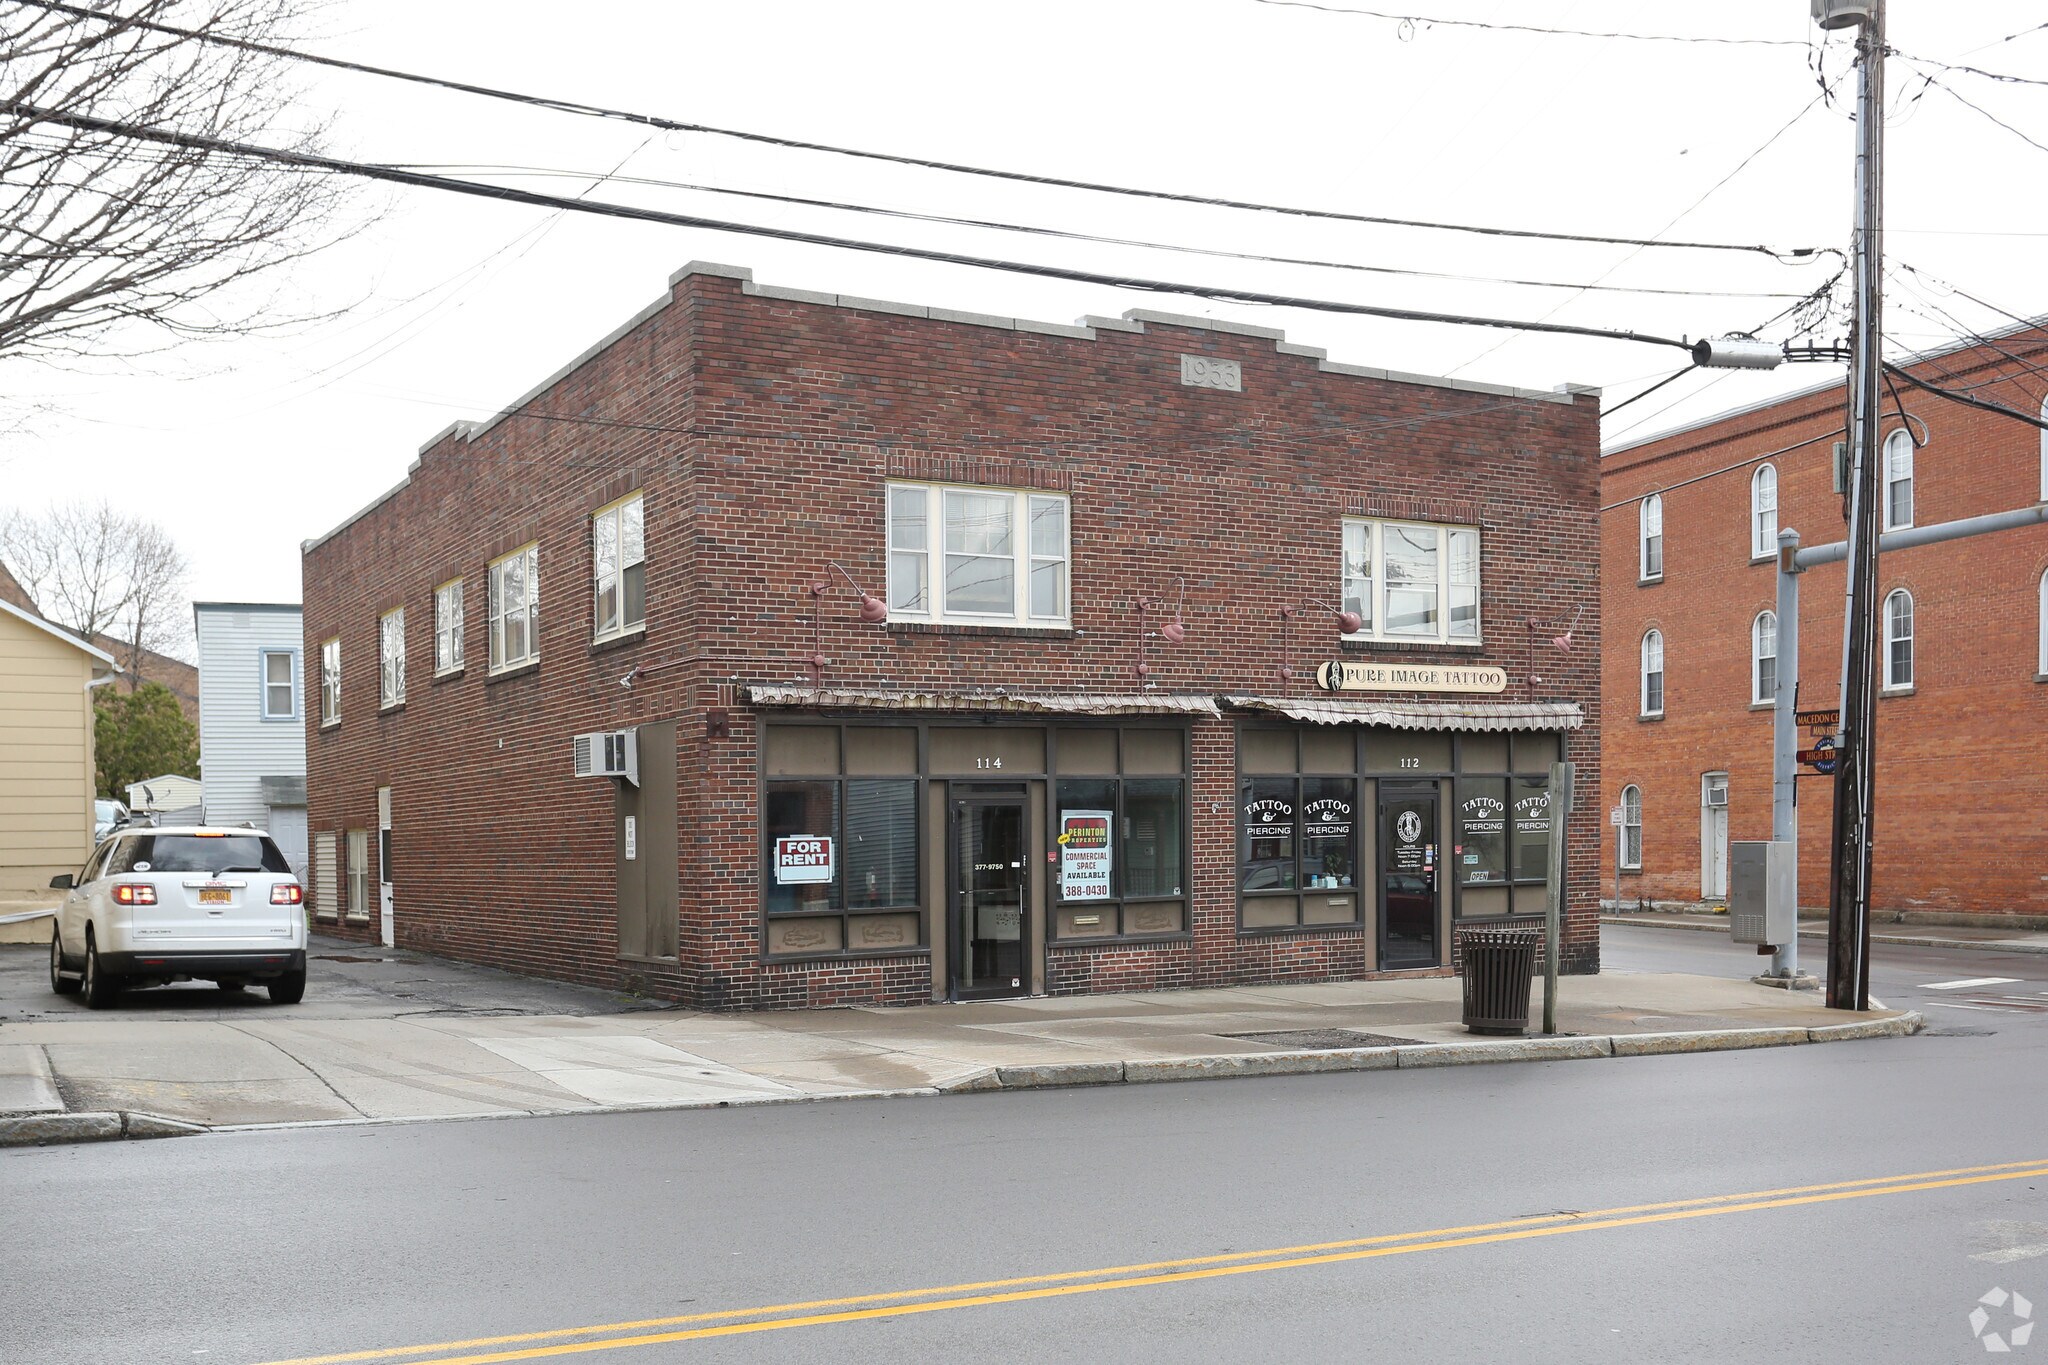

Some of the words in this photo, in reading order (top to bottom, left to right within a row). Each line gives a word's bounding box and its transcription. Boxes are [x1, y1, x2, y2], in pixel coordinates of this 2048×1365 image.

[1346, 669, 1386, 683] PURE
[1391, 670, 1439, 684] IMAGE
[1444, 672, 1501, 686] TATTOO
[1797, 714, 1830, 724] MACEDON
[1830, 713, 1839, 722] CE
[1813, 726, 1826, 736] MAIN
[1826, 726, 1838, 735] STRE
[1806, 751, 1823, 761] HIGH
[1825, 750, 1836, 760] STR
[976, 757, 1002, 769] 114
[1400, 757, 1419, 768] 112
[1244, 799, 1292, 815] TATTOO
[1304, 799, 1350, 815] TATTOO
[1462, 797, 1504, 812] TATTOO
[1514, 797, 1549, 812] TATTO
[1262, 811, 1277, 822] &
[1322, 811, 1336, 821] &
[1478, 808, 1490, 818] &
[1530, 808, 1542, 818] &
[1247, 827, 1291, 835] PIERCING
[1307, 826, 1349, 834] PIERCING
[1464, 822, 1503, 830] PIERCING
[1517, 822, 1550, 830] PIERCIN
[1068, 827, 1106, 837] PERINTON
[787, 841, 821, 853] FOR
[781, 853, 827, 865] RENT
[1065, 852, 1107, 861] COMMERCIAL
[1076, 862, 1096, 870] SPACE
[1472, 872, 1488, 880] OPEN
[1065, 885, 1107, 896] 388-0430
